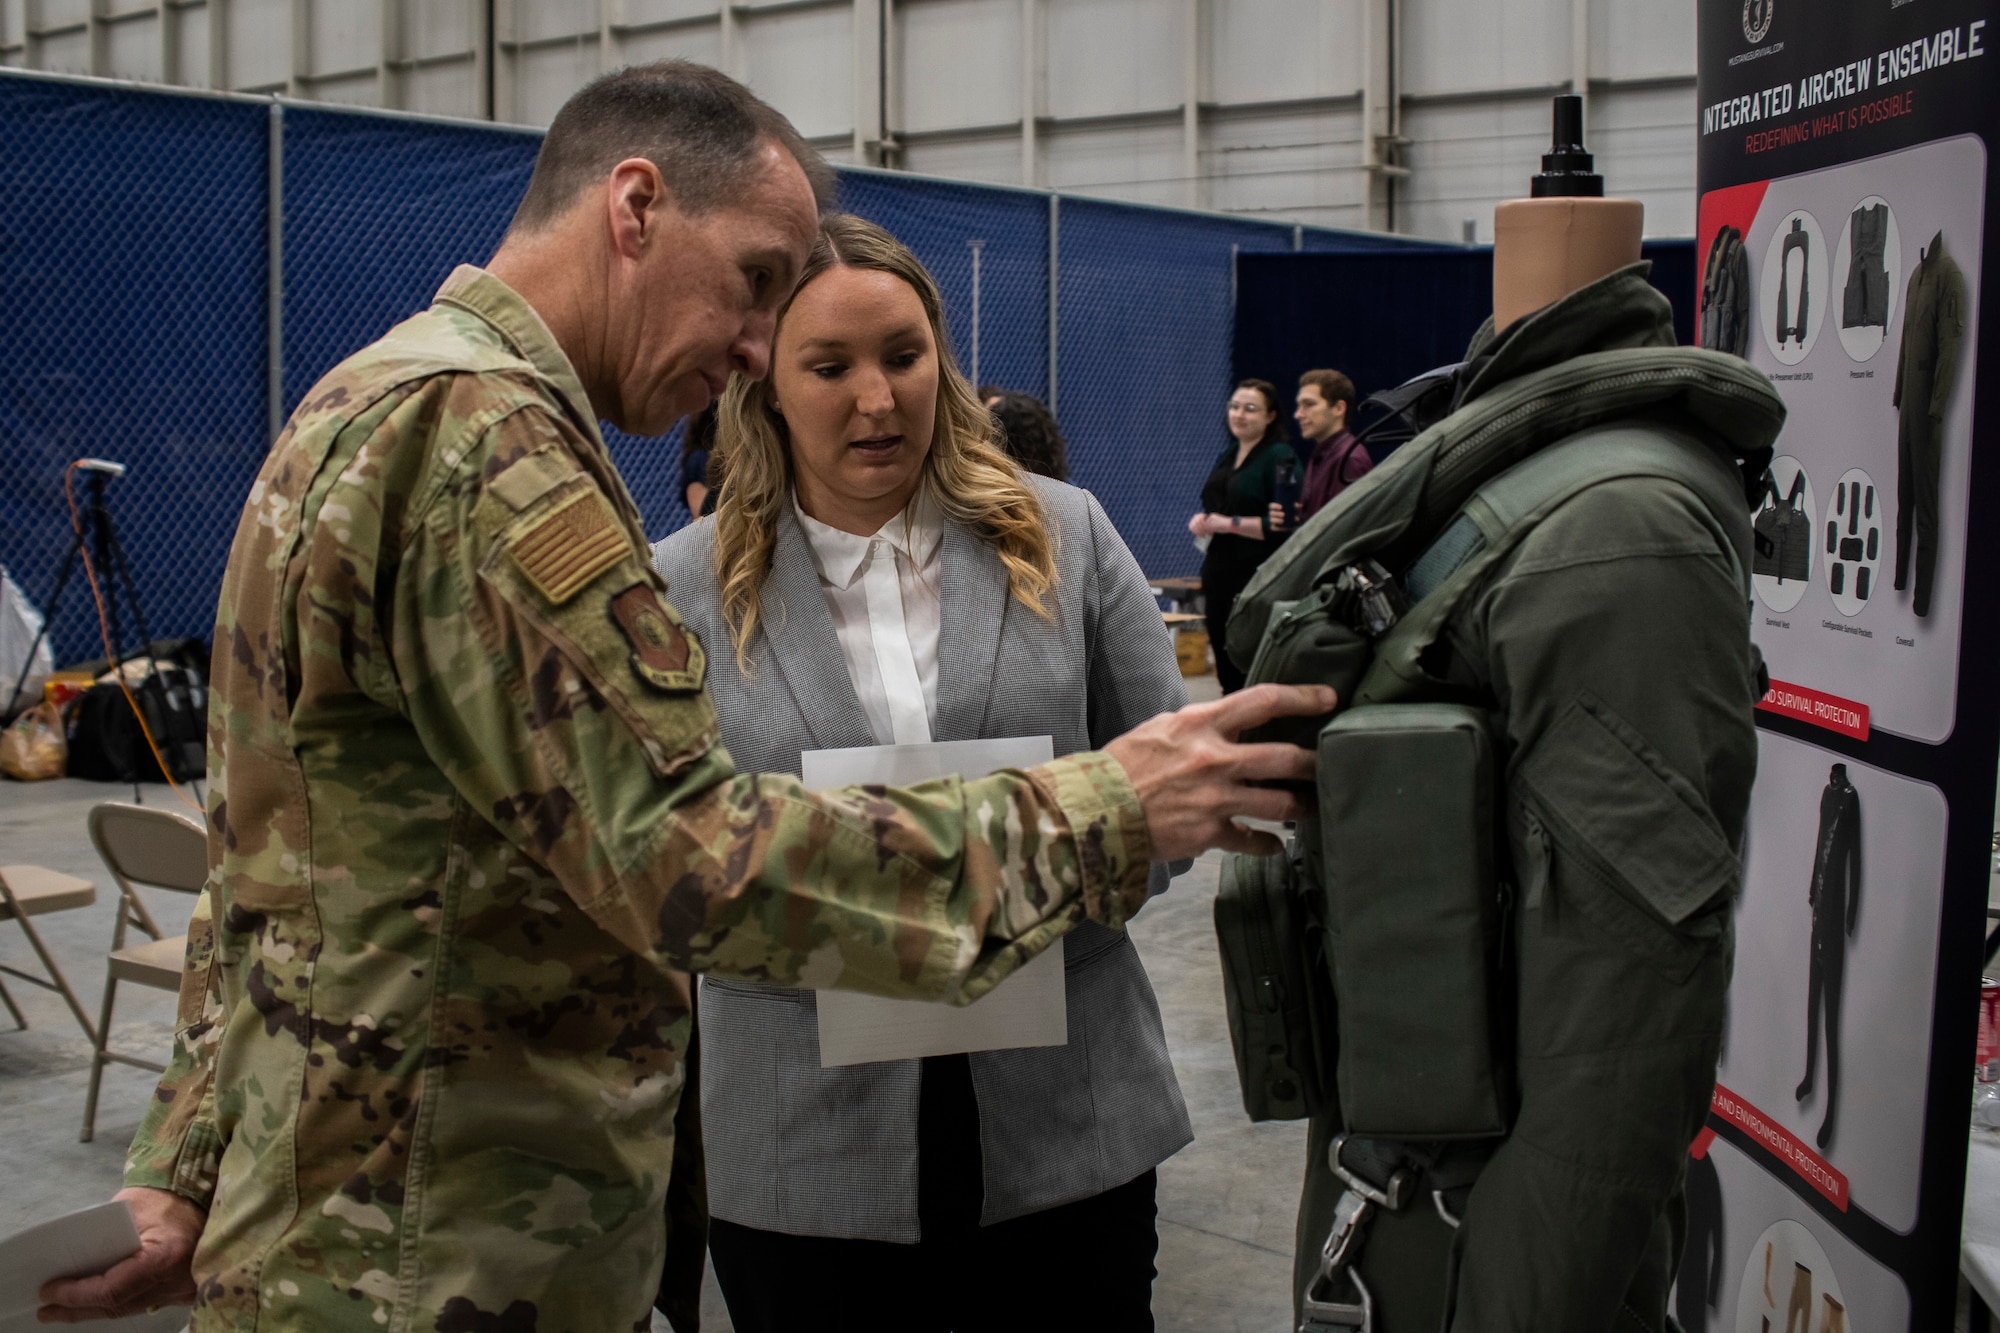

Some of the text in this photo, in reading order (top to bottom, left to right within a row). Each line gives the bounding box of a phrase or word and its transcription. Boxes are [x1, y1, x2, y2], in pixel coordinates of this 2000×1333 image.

[1728, 42, 1785, 66] MUSTANGSURVIVAL.COM
[1702, 19, 1986, 136] INTEGRATED AIRCREW ENSEMBLE
[1745, 90, 1914, 154] REDEFINING WHAT IS POSSIBLE
[1865, 370, 1874, 378] Vest
[1766, 618, 1790, 629] Survival Vest
[1822, 619, 1873, 639] Configurable Survival Pockets
[1895, 636, 1915, 647] Coverall
[1777, 690, 1814, 715] SURVIVAL
[1815, 701, 1861, 730] PROTECTION
[1718, 1095, 1840, 1197] AND ENVIRONMENTAL PROTECTION
